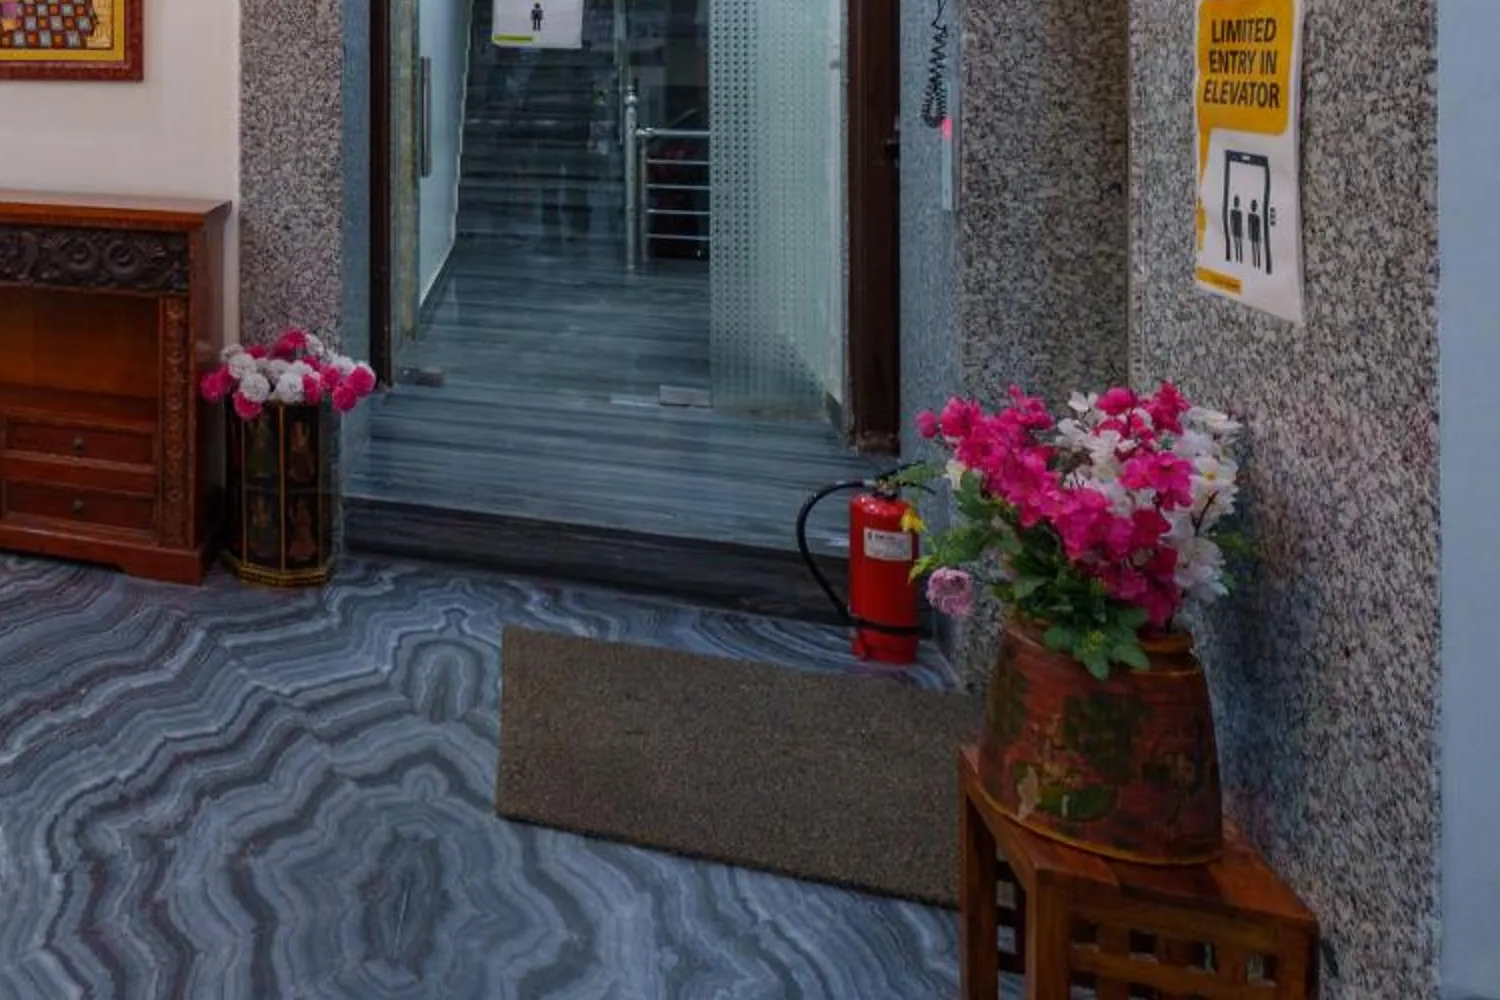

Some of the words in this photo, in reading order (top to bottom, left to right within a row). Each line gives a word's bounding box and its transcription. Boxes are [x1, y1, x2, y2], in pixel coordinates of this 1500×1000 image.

[1211, 18, 1277, 44] LIMITED
[1209, 49, 1256, 75] ENTRY
[1260, 50, 1278, 75] IN
[1203, 79, 1280, 109] ELEVATOR
